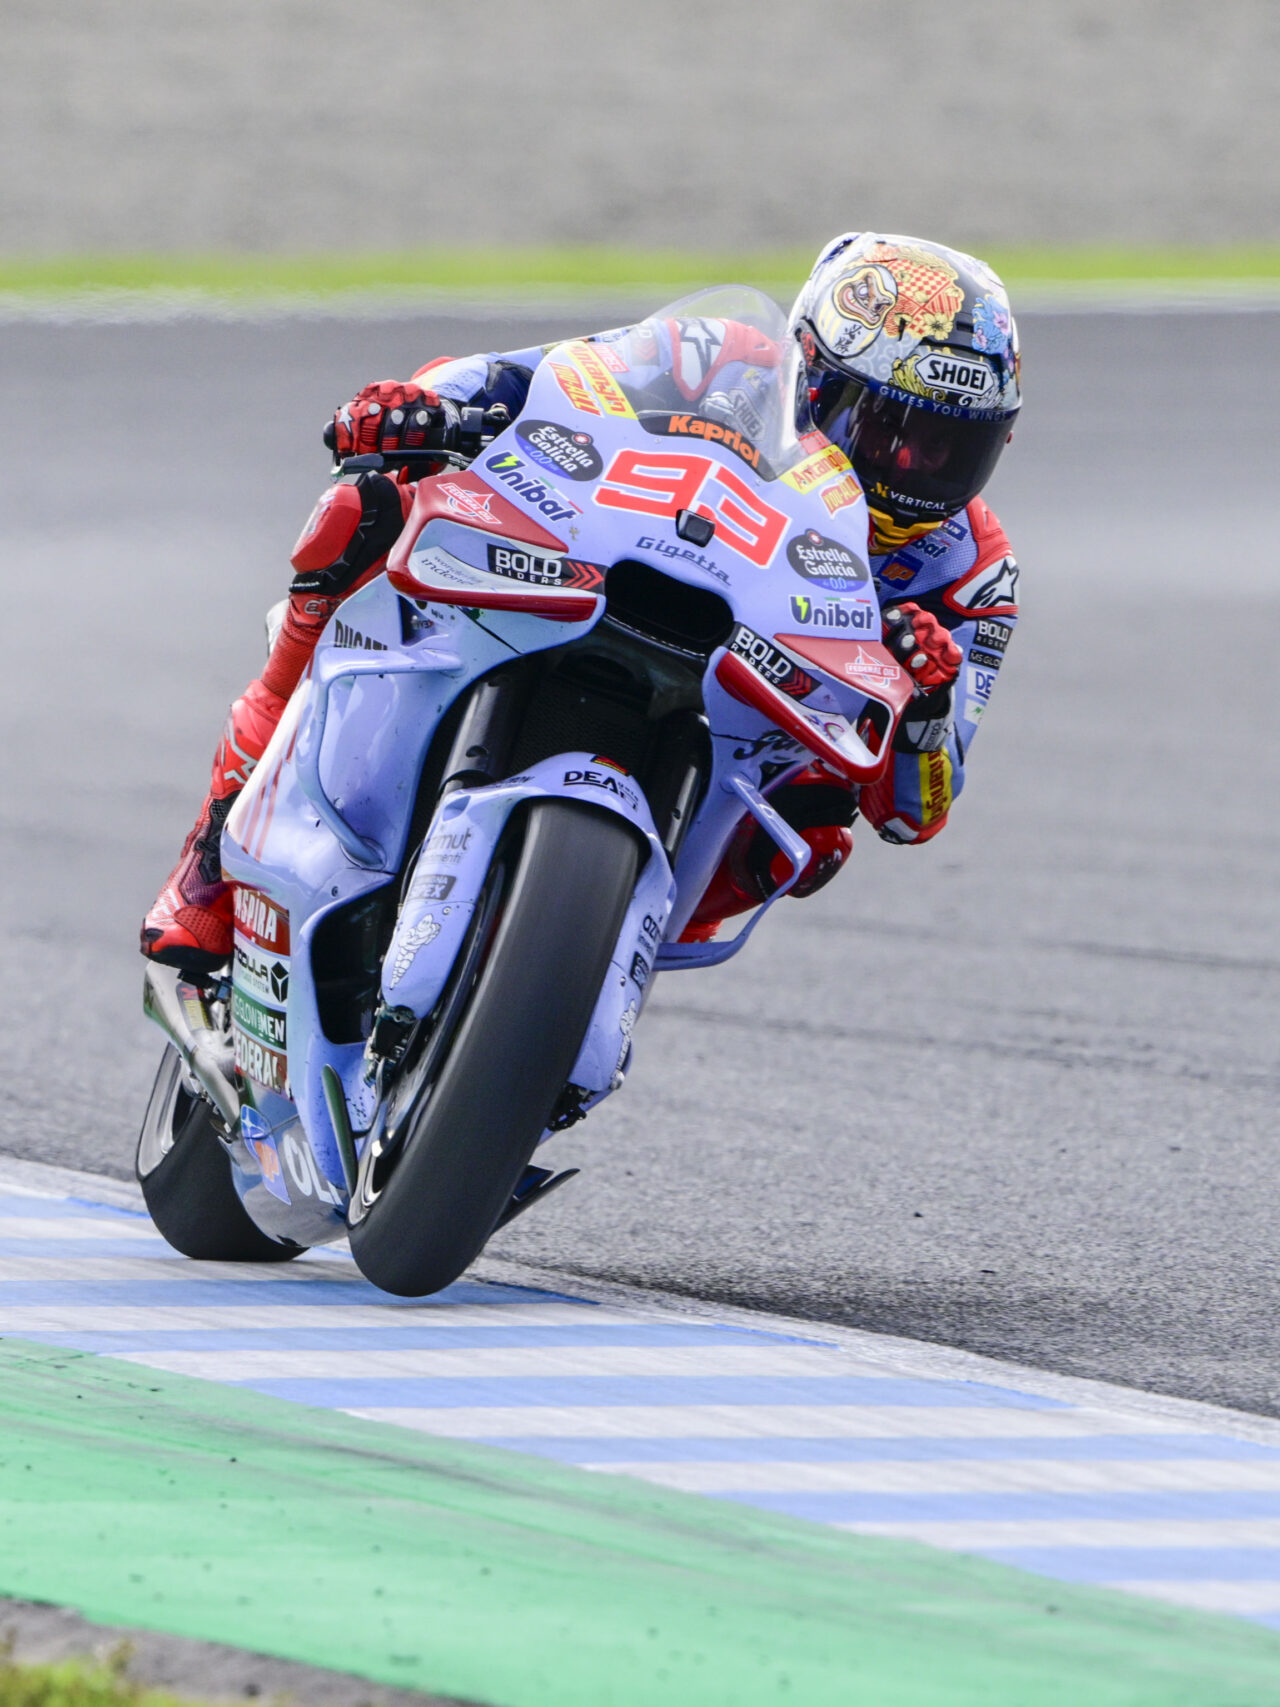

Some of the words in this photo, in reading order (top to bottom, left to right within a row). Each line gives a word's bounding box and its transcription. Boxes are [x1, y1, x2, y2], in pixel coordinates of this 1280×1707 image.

[927, 360, 988, 390] SHOEI
[879, 385, 925, 408] GIVES
[932, 402, 962, 417] YOU
[968, 409, 1008, 422] WINGS
[528, 432, 578, 472] Galicia
[537, 425, 594, 468] Estrella
[668, 415, 761, 467] Kapriol
[486, 452, 578, 522] Unibat
[890, 490, 946, 511] VERTICAL
[592, 448, 792, 569] 93
[495, 548, 562, 578] BOLD
[635, 536, 731, 587] Gigetta
[796, 544, 852, 563] Estrella
[804, 560, 857, 578] Galicia
[495, 566, 562, 586] RIDERS
[790, 595, 875, 630] Unibat
[334, 619, 388, 651] DUCA
[978, 620, 1009, 641] BOLD
[730, 642, 781, 684] RIDERS
[735, 626, 792, 678] BOLD
[983, 655, 1000, 667] GLO
[259, 1013, 284, 1043] MEN
